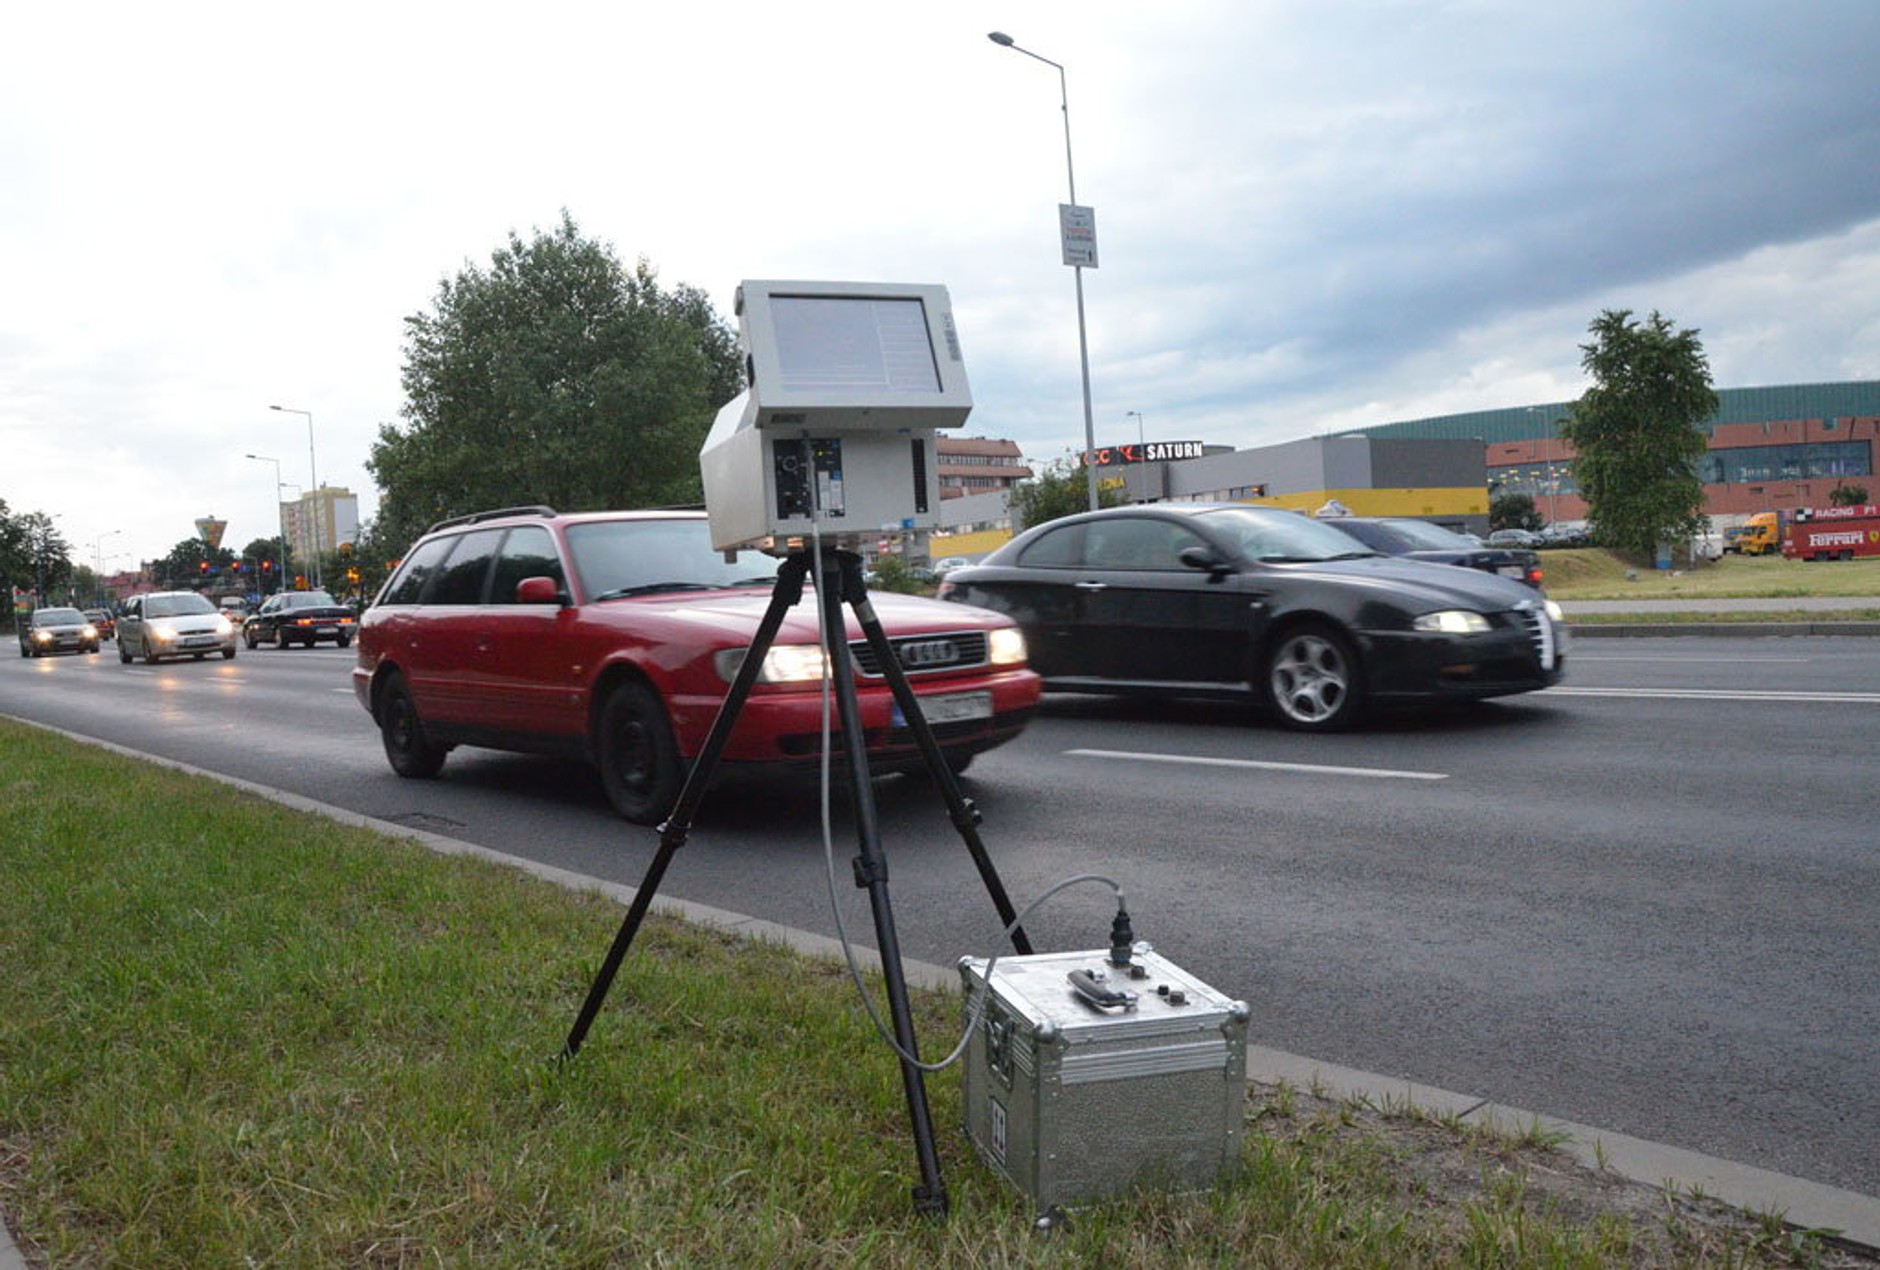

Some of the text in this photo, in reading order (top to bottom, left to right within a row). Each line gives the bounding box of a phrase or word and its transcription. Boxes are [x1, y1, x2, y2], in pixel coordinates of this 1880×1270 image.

[1147, 443, 1203, 460] SATURN
[1815, 507, 1854, 518] RACING
[1809, 531, 1864, 546] Ferrari
